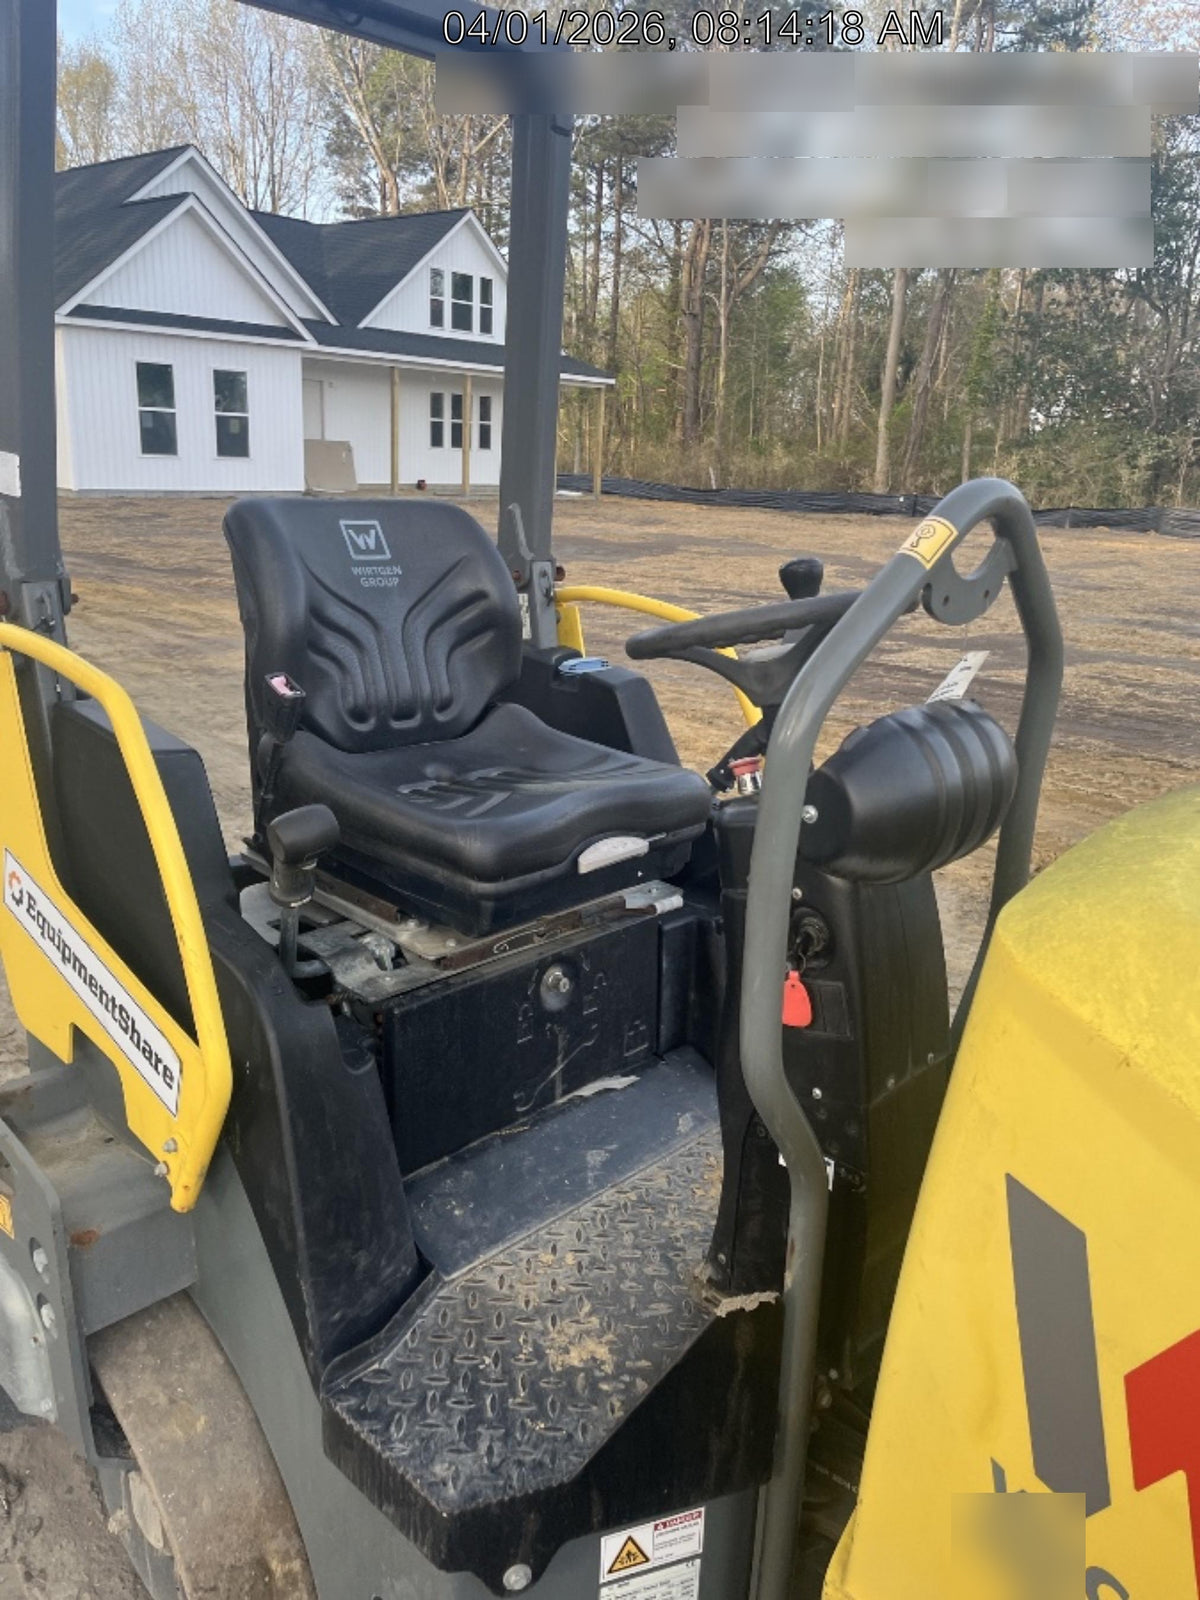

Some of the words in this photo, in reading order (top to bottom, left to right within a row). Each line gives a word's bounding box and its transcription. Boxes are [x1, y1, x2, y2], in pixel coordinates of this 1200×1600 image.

[348, 529, 376, 550] W
[351, 565, 402, 576] WIRTGEN
[360, 577, 399, 588] GROUP
[26, 890, 175, 1090] EquipmentShare
